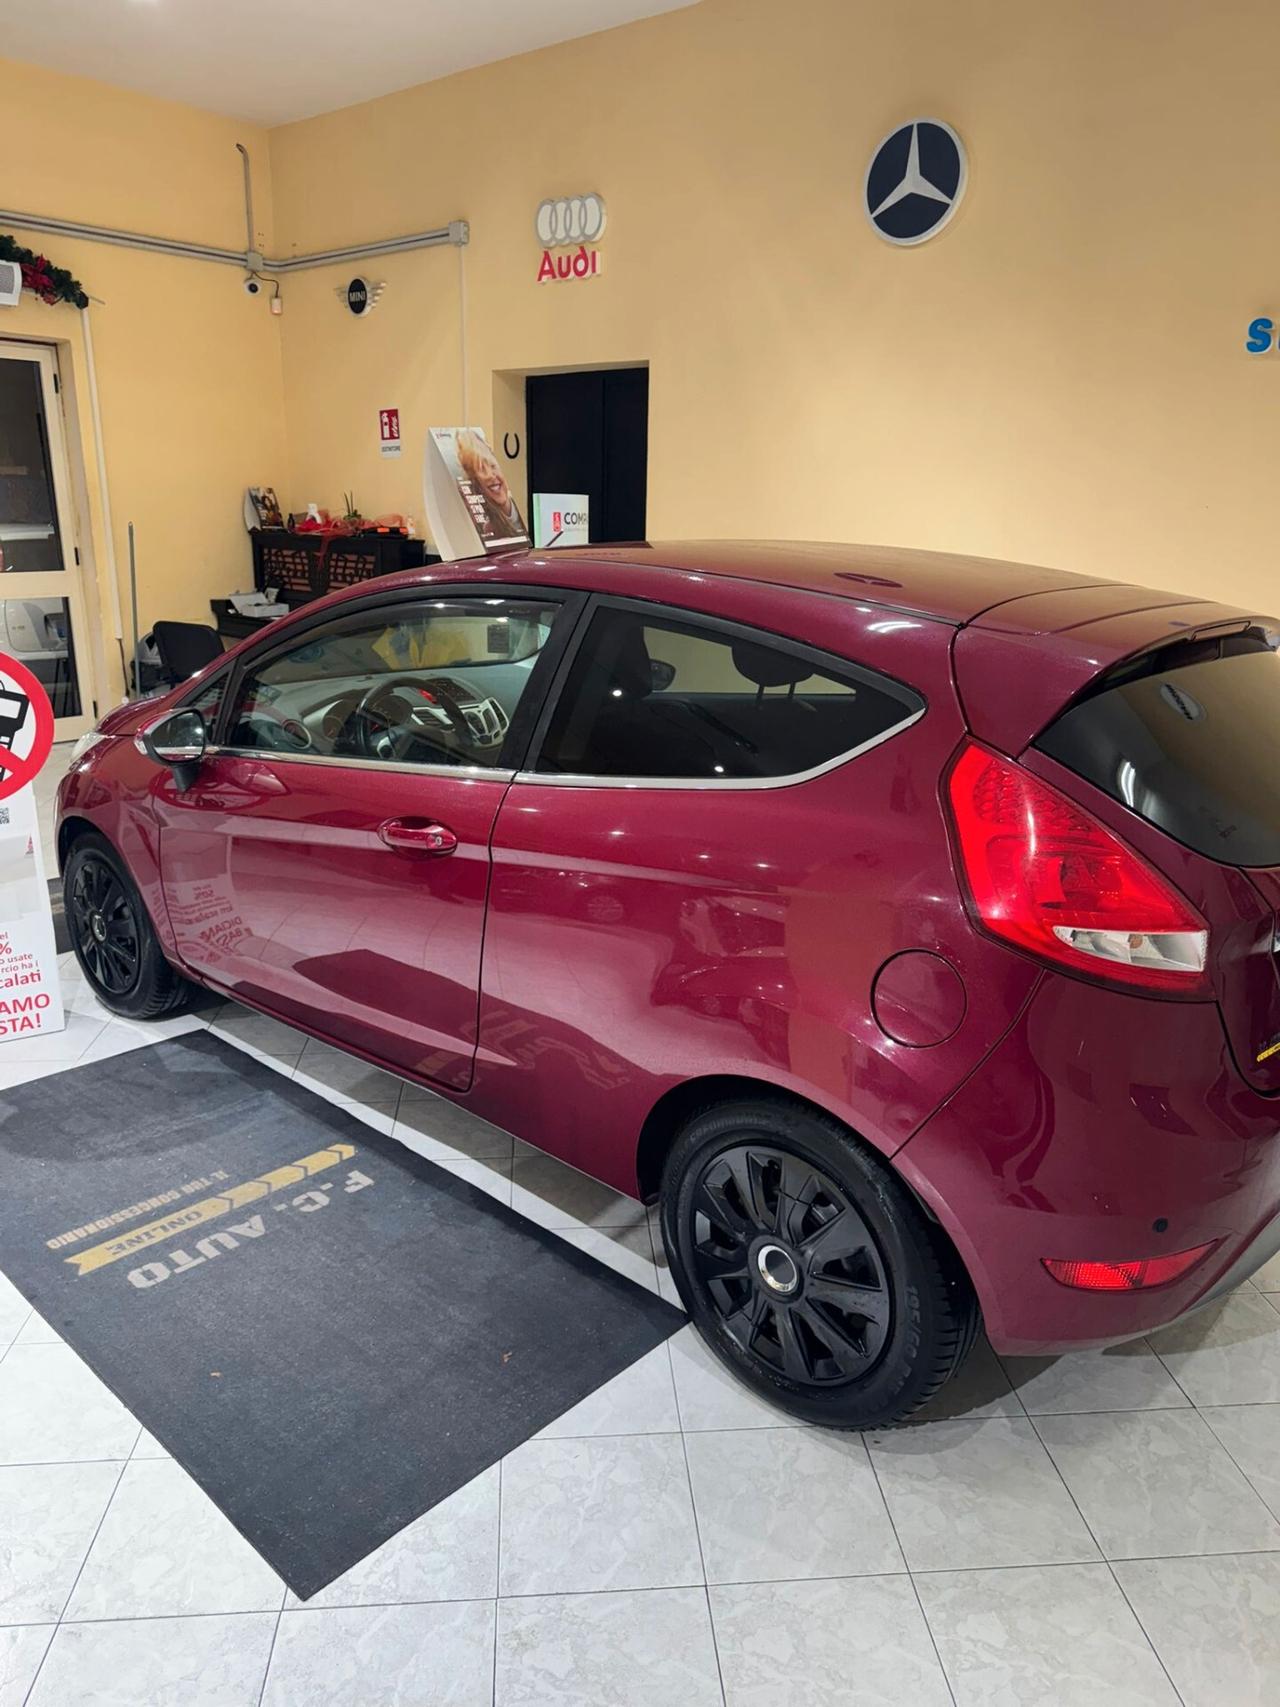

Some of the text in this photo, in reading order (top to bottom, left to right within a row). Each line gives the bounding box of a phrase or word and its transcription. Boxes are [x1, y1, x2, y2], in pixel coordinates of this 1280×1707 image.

[537, 246, 597, 281] Audi
[1246, 318, 1280, 353] S
[7, 953, 33, 963] usate
[21, 962, 33, 970] ha
[46, 1190, 182, 1250] CONCESSIONARIO
[104, 1209, 203, 1256] ONLINE
[127, 1214, 266, 1288] AUTO
